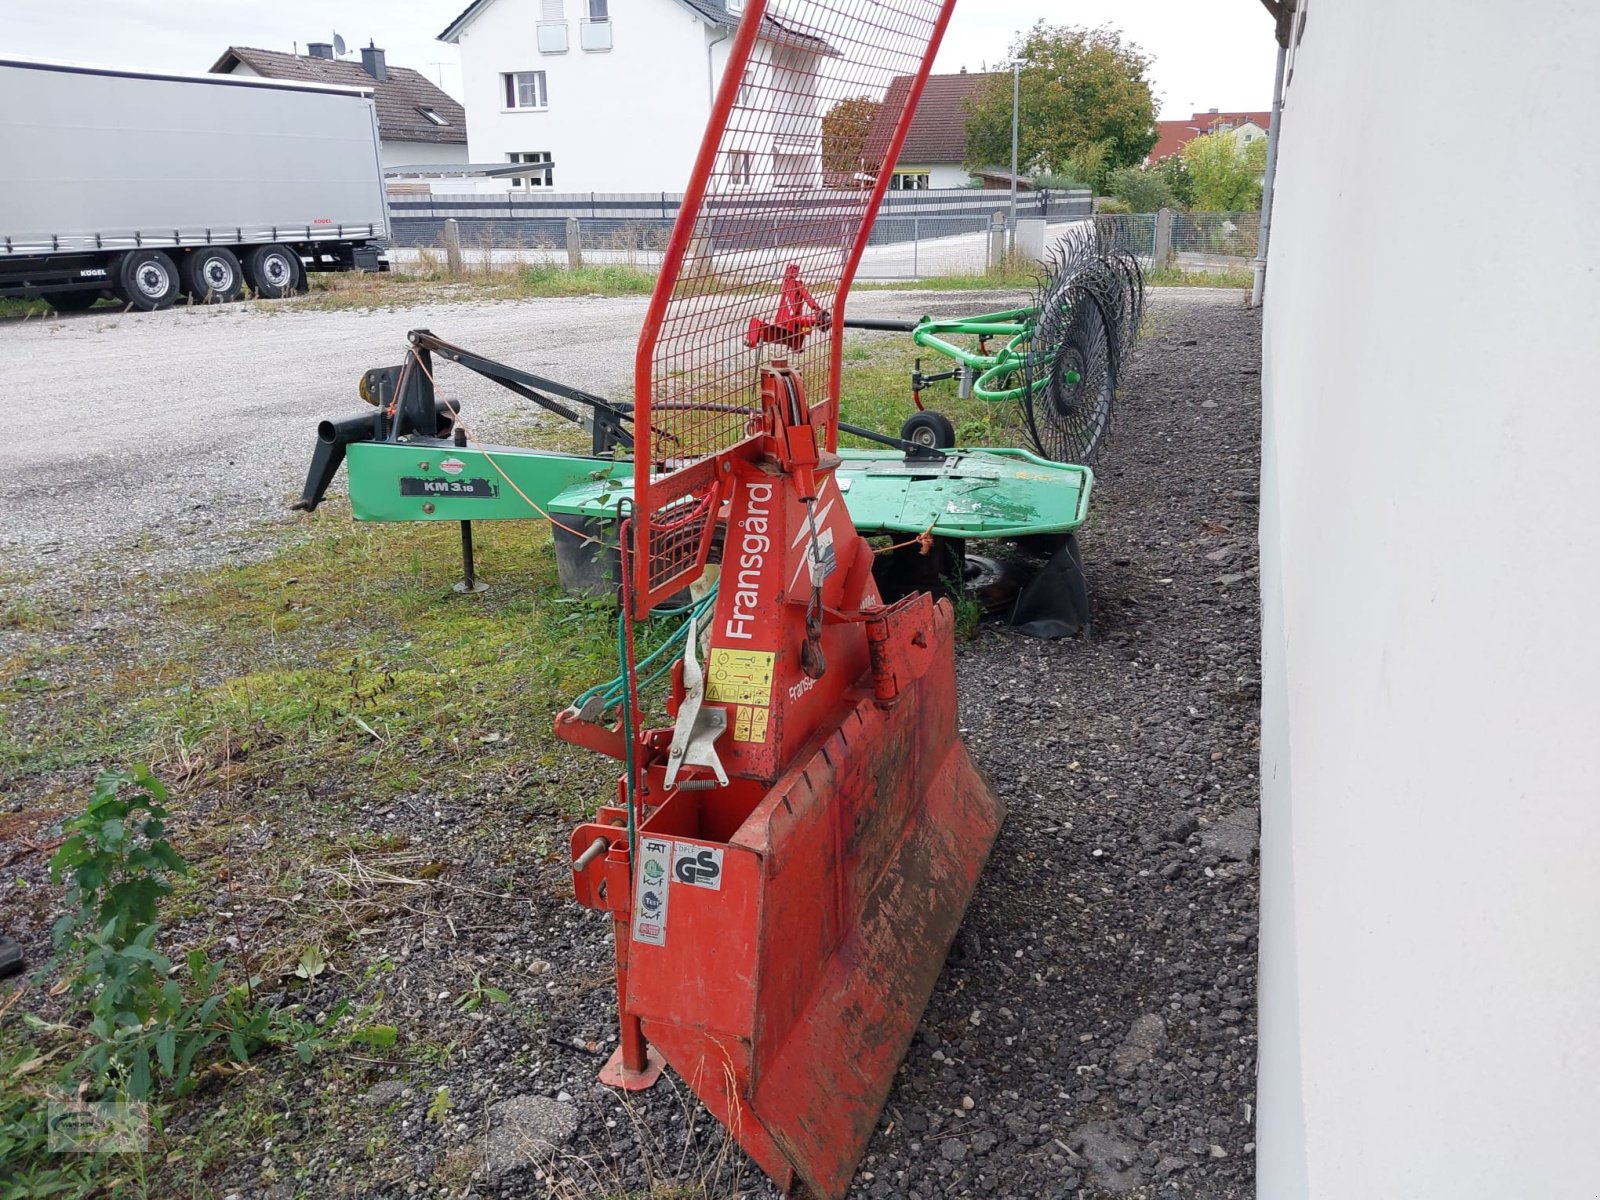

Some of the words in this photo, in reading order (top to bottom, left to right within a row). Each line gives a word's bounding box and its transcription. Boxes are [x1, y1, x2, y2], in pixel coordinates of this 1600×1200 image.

[424, 482, 449, 492] KM
[451, 482, 474, 493] 3.18
[725, 482, 773, 640] Fransgård
[675, 850, 720, 884] GS
